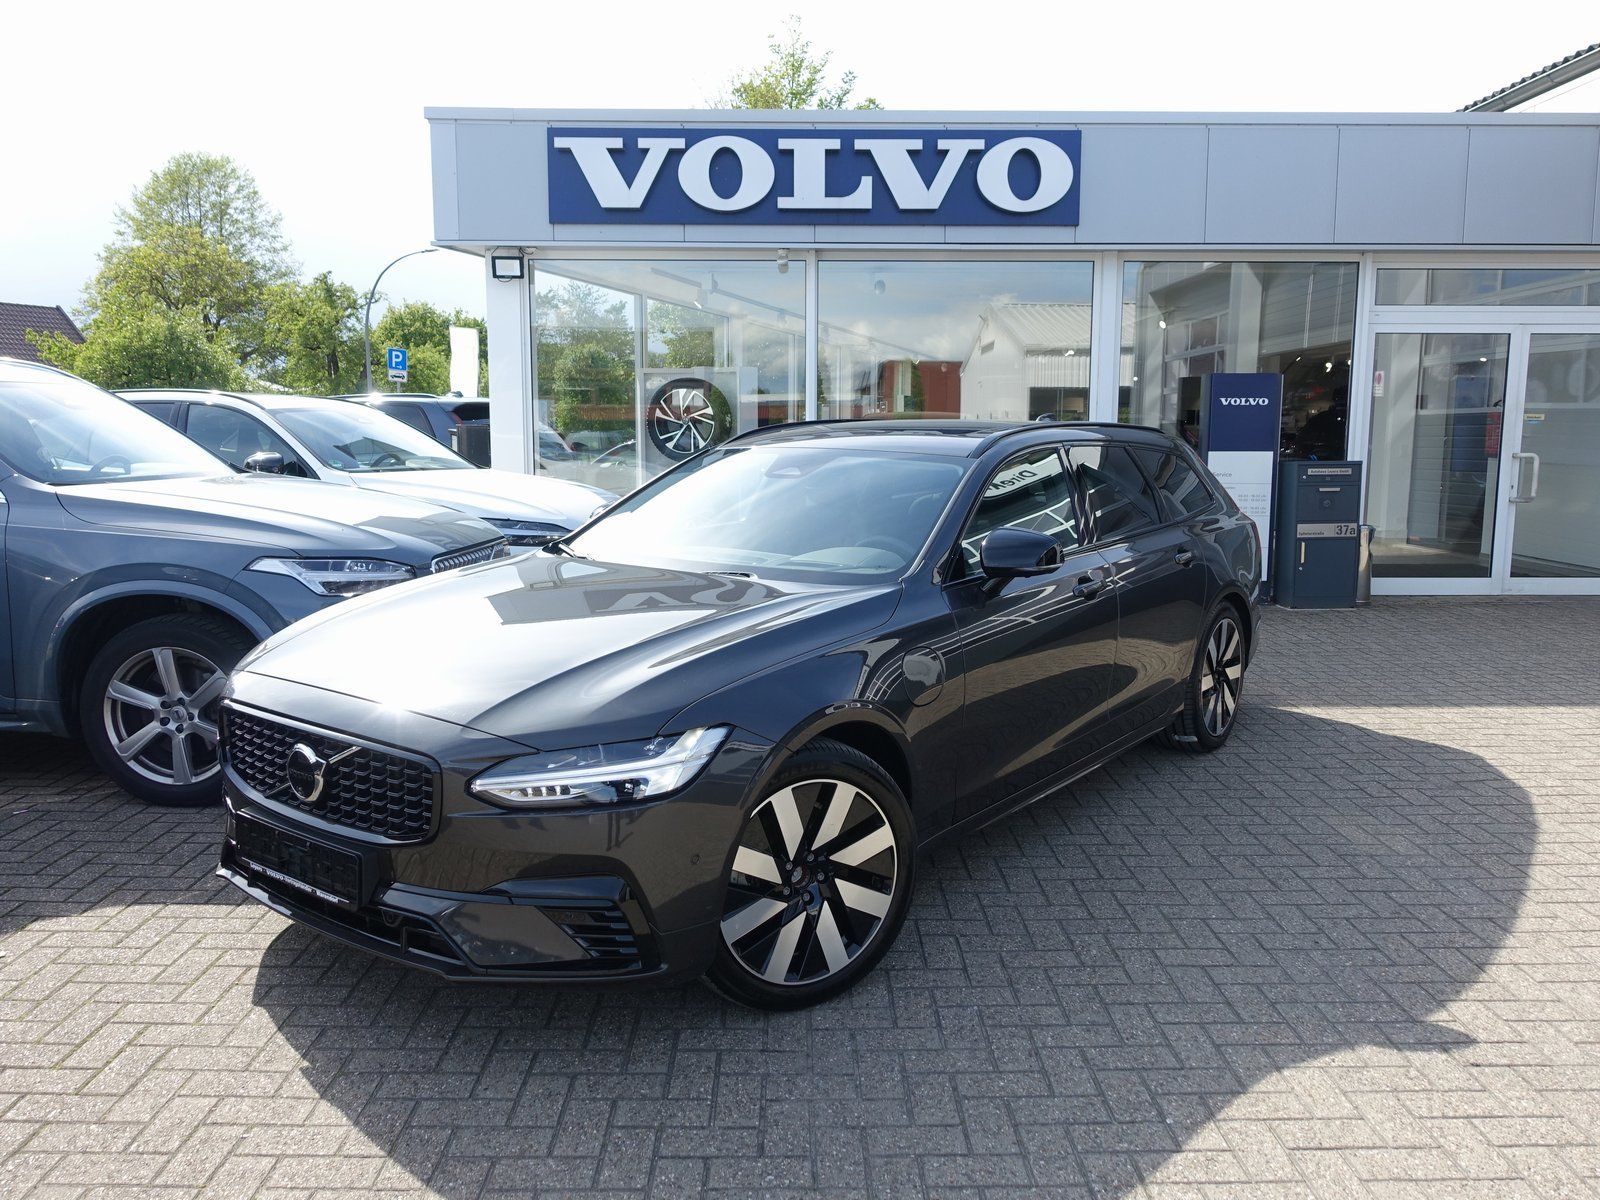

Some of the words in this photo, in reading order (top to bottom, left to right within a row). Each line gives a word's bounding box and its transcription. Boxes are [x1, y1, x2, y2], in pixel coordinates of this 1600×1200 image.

[554, 135, 1074, 213] VOLVO
[392, 351, 403, 367] P
[1219, 398, 1269, 406] VOLVO
[1336, 524, 1356, 536] 37a
